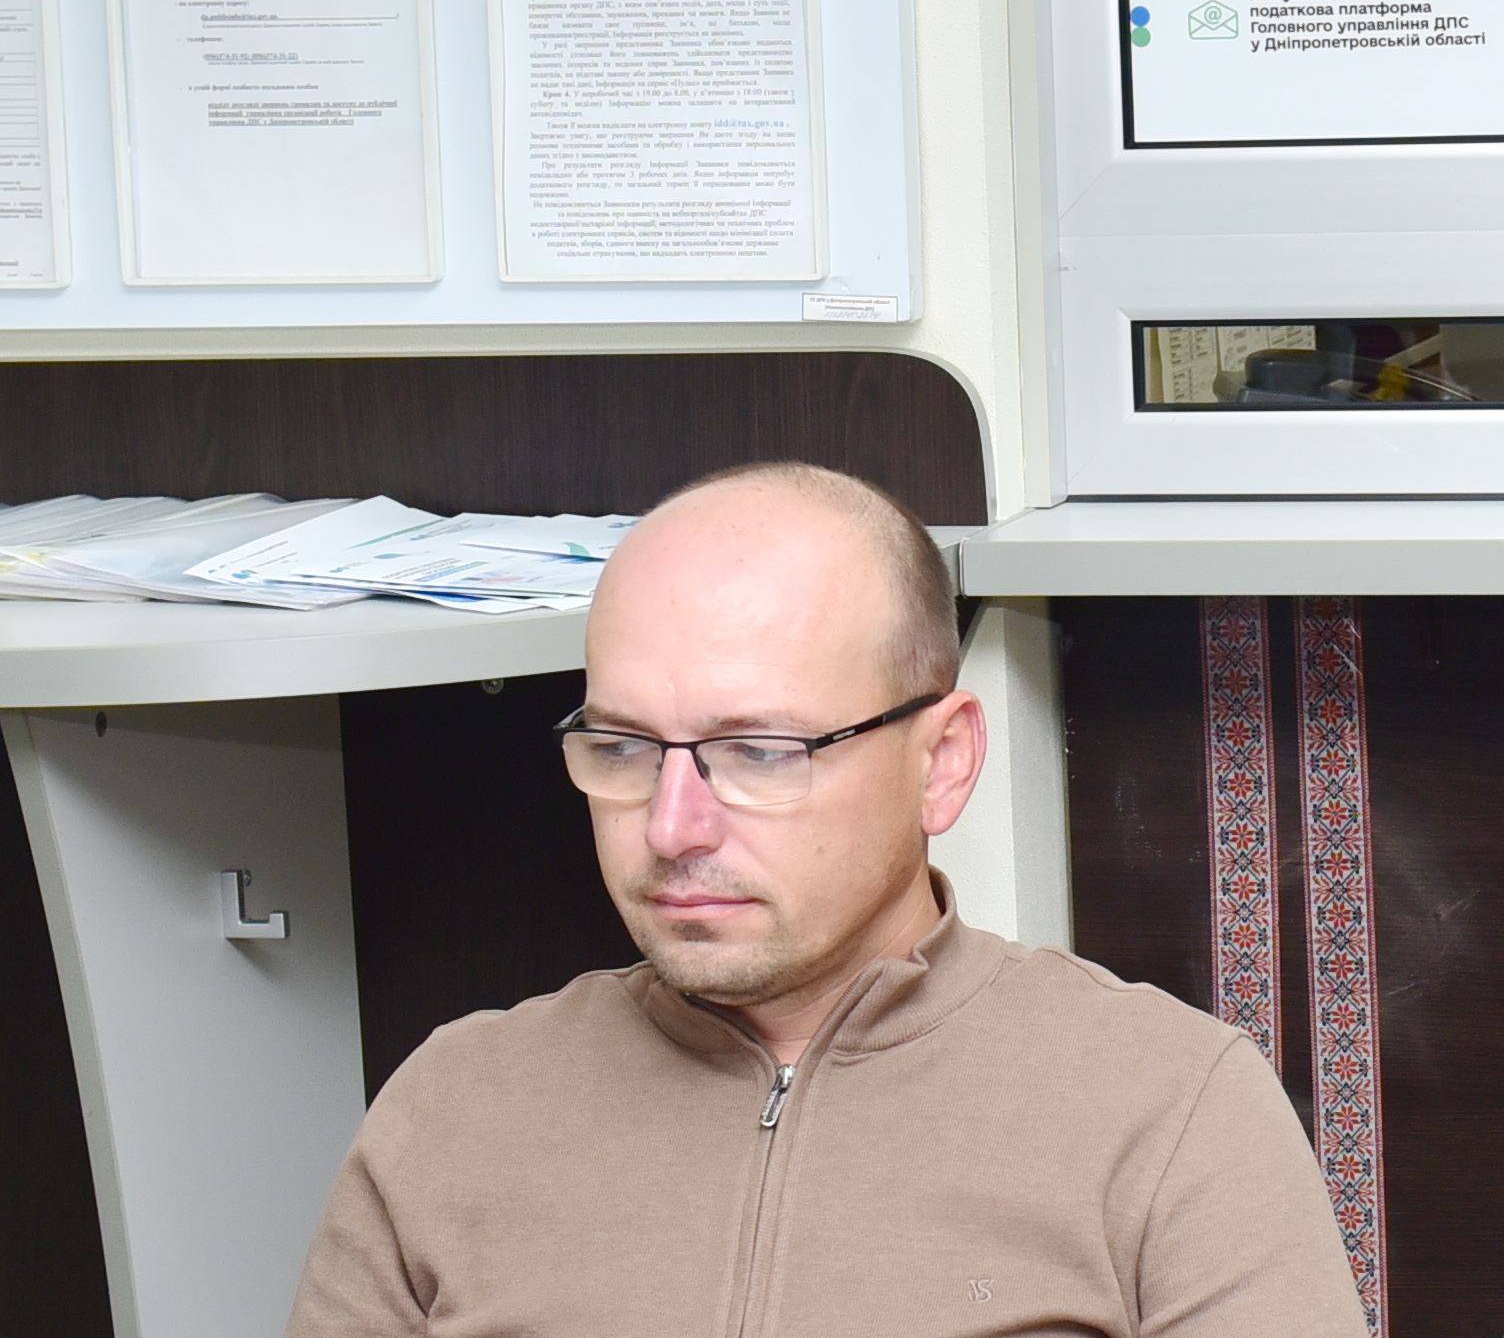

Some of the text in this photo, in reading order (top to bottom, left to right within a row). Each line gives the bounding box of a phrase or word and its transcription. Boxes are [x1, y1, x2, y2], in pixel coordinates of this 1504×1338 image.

[1250, 1, 1432, 19] податкова платформа
[1250, 16, 1469, 35] Головного управління ДПС
[1250, 32, 1486, 53] у Дніпропетровській області
